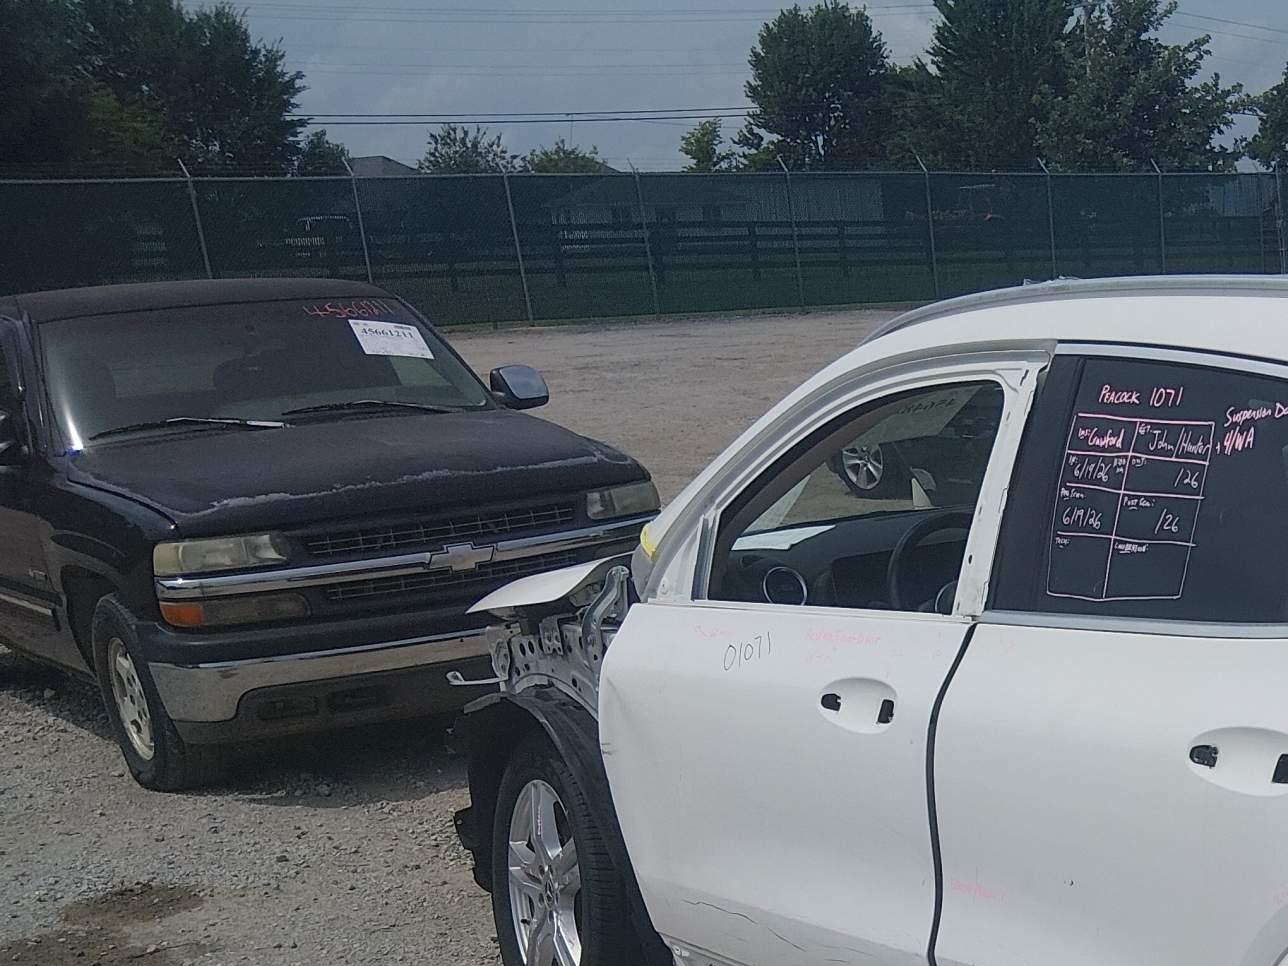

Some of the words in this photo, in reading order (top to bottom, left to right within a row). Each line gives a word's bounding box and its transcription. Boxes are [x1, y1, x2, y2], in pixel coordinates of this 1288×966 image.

[361, 327, 414, 339] 45661211
[1149, 386, 1184, 407] 1071
[1062, 506, 1102, 530] 6/19/26
[723, 631, 771, 671] 01071
